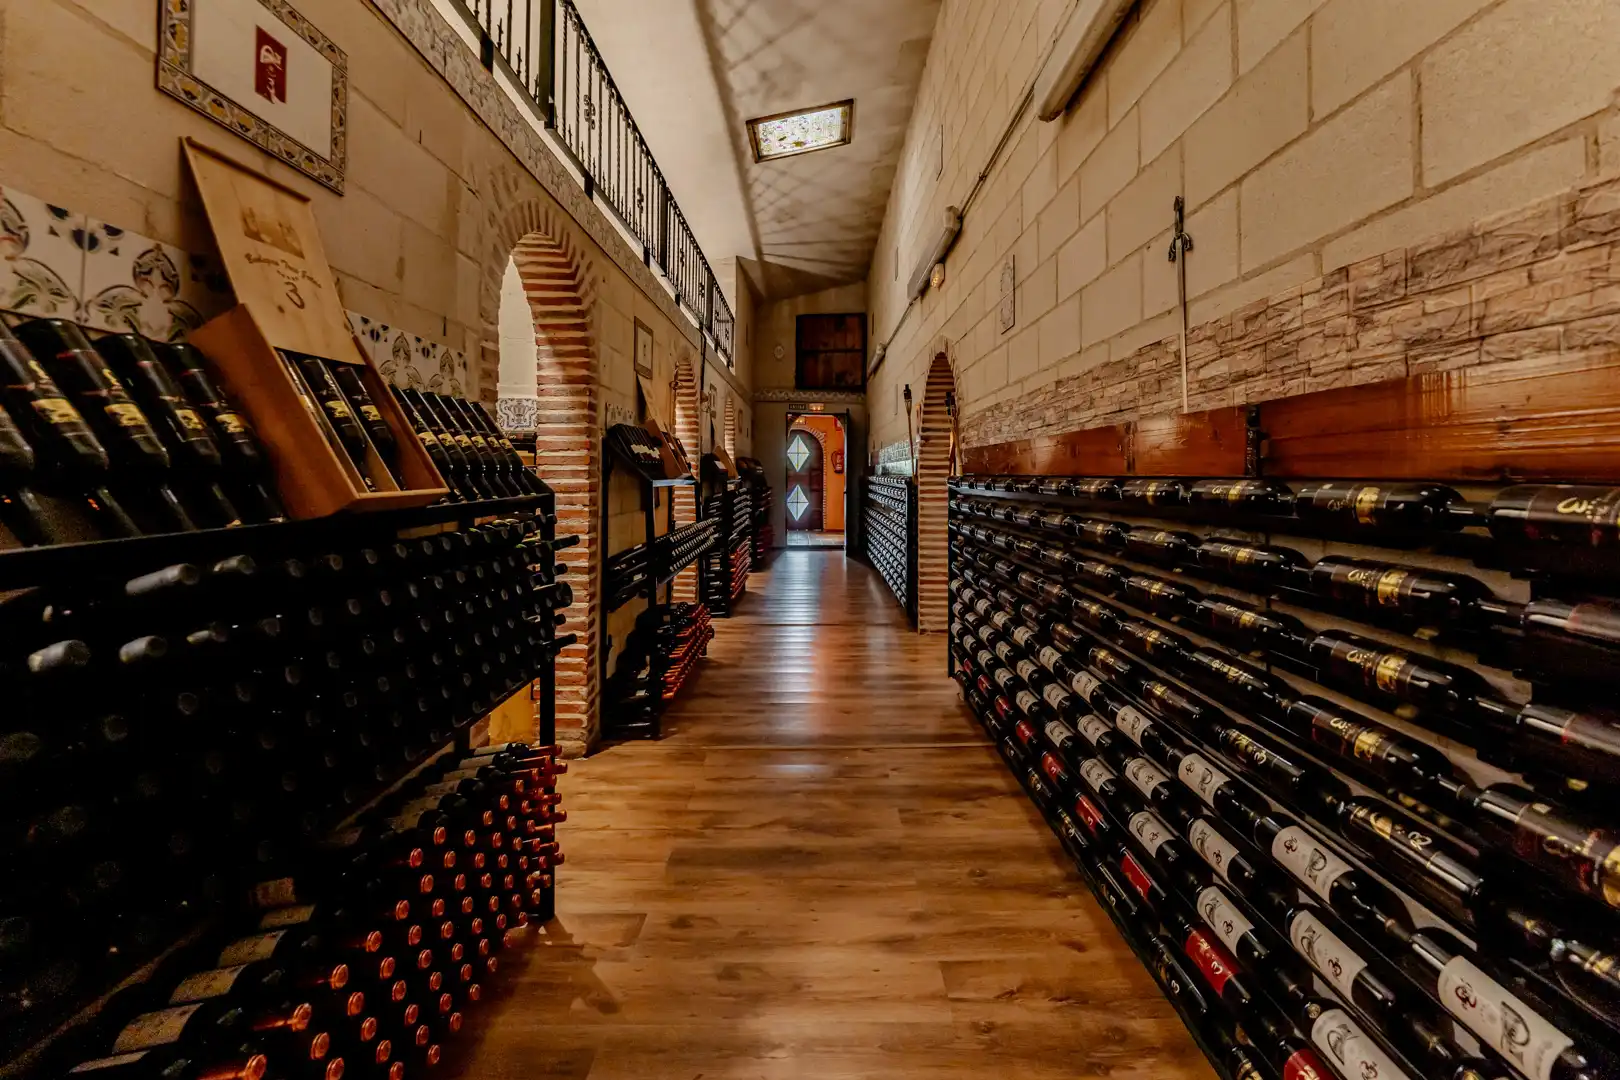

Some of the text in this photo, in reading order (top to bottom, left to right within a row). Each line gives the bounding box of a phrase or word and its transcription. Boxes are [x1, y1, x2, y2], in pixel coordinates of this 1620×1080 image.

[284, 281, 305, 309] 3
[1211, 961, 1223, 975] 3
[1171, 979, 1180, 994] 3
